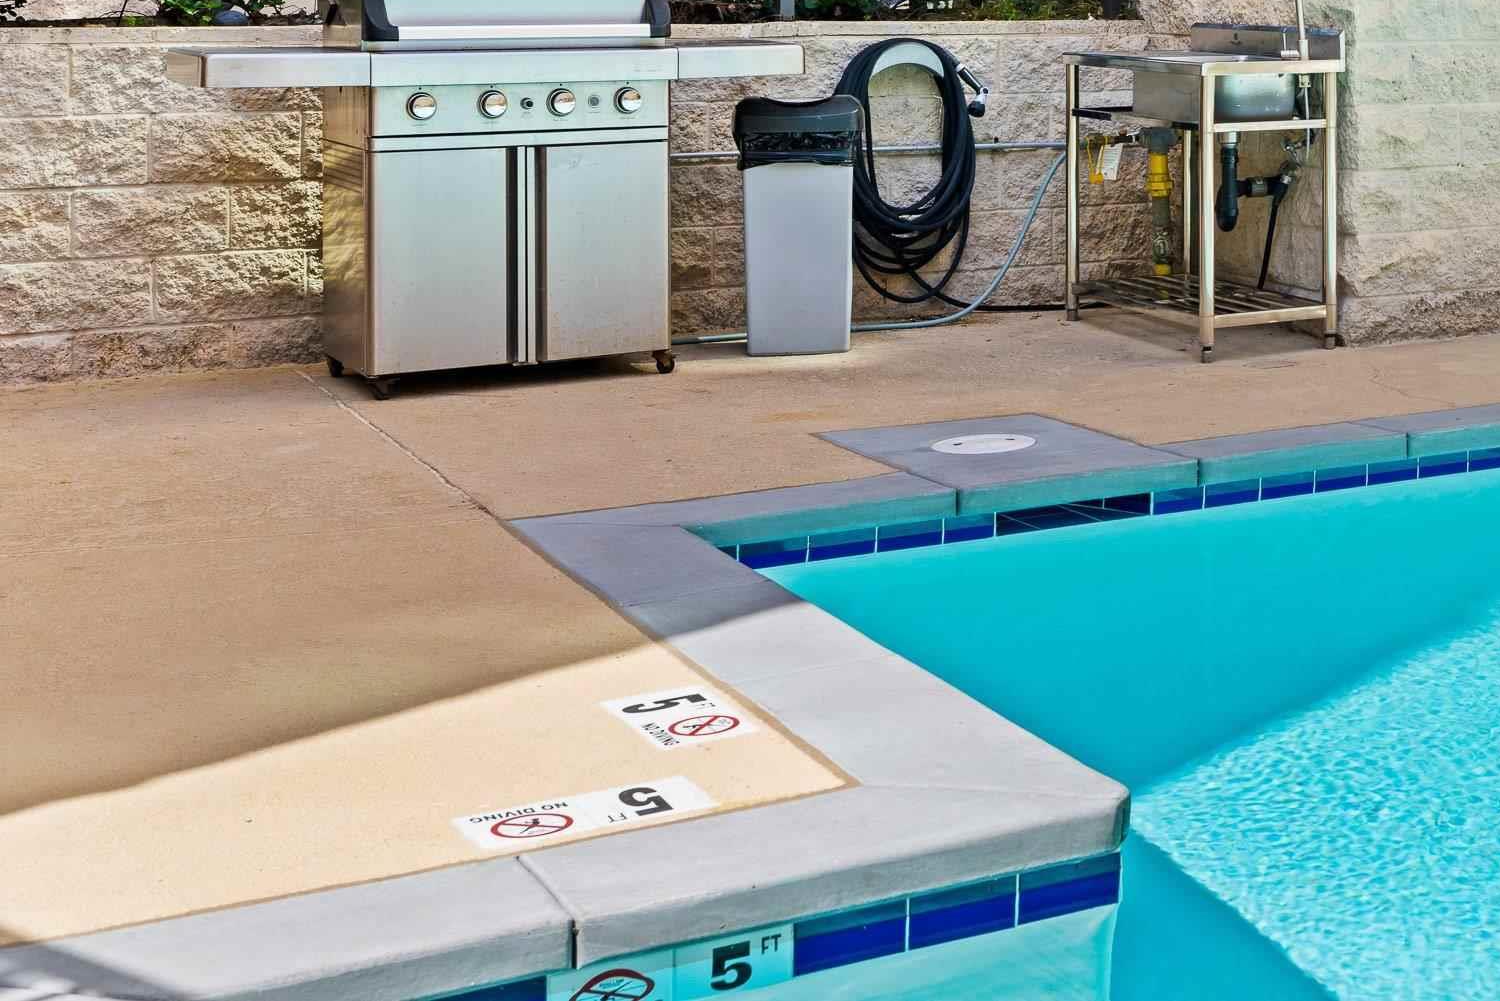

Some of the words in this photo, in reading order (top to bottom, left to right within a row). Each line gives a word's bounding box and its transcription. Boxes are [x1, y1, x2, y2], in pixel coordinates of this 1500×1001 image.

[622, 693, 707, 713] 5
[541, 801, 569, 811] NO
[618, 786, 674, 816] 5
[469, 808, 536, 824] DIVING
[711, 941, 752, 992] 5
[760, 934, 782, 955] FT
